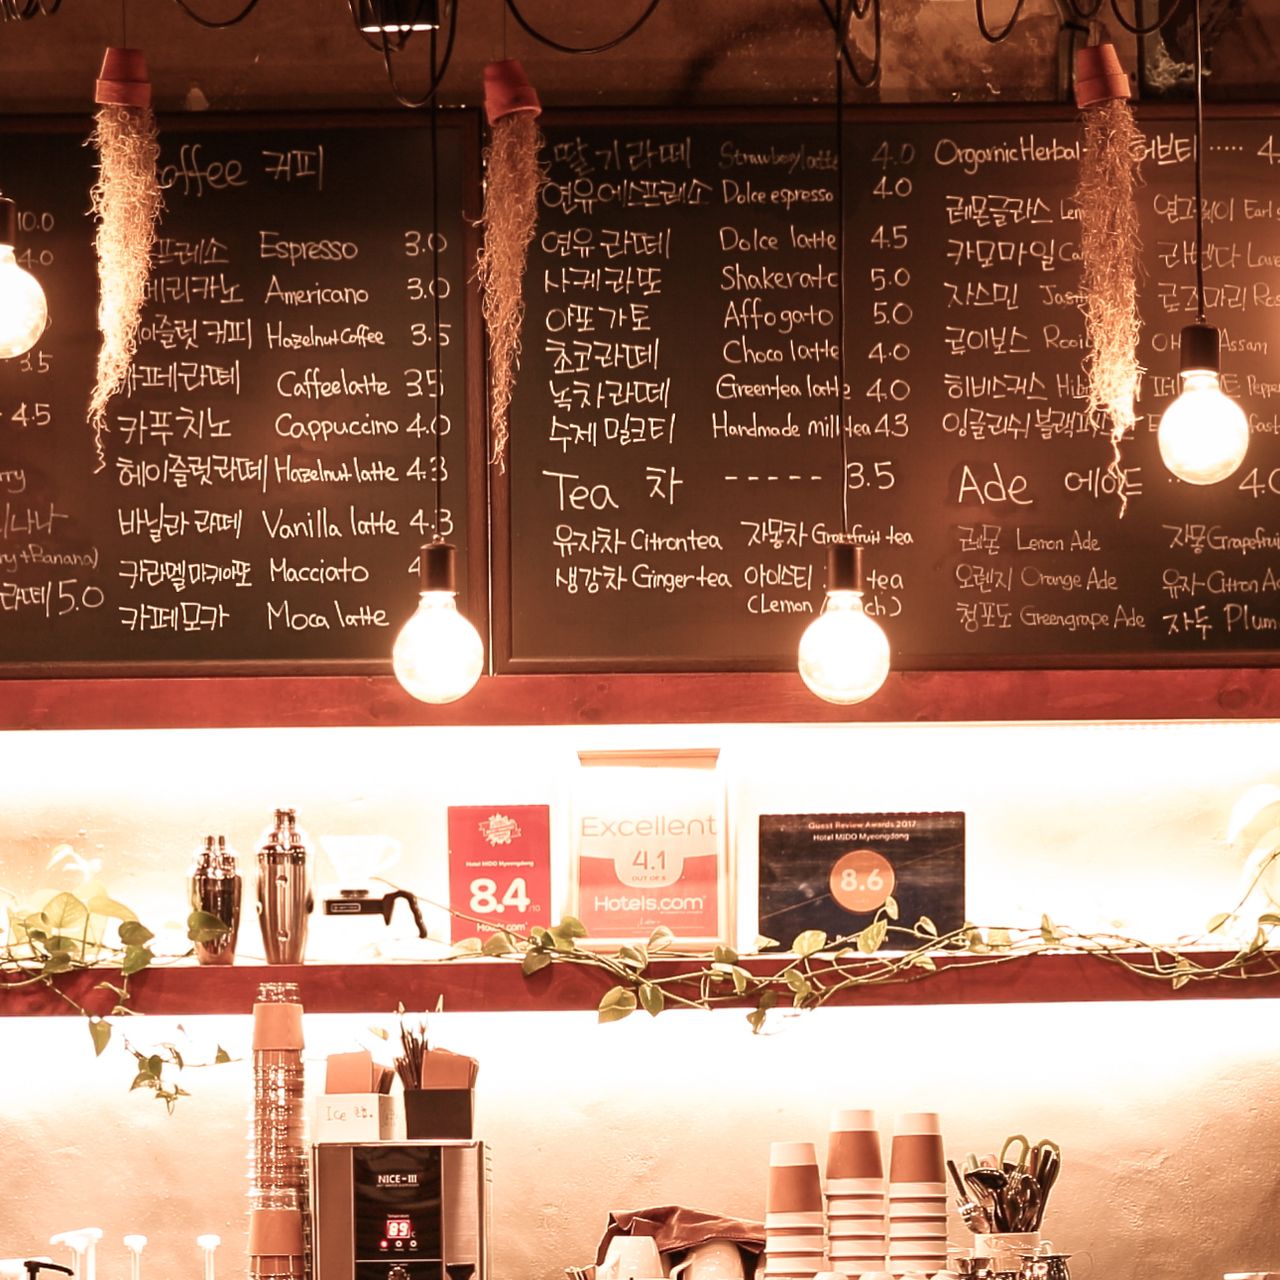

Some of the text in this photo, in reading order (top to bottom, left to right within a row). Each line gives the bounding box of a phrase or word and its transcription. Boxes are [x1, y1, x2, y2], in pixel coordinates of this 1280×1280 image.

[871, 140, 916, 170] 4.0
[1019, 133, 1080, 164] Herbal
[261, 144, 324, 192] 커피
[722, 178, 834, 211] Dolce espresso
[1243, 197, 1274, 220] Earl
[258, 230, 448, 267] Espresso 3.0
[719, 224, 908, 251] Dolce latte 4.5
[946, 239, 1055, 272] 카모마일
[264, 274, 451, 306] Americano 3.0
[870, 266, 911, 291] 5.0
[943, 281, 1020, 311] 자스민
[873, 301, 914, 325] 5.0
[202, 317, 453, 351] 커피 3.5
[722, 334, 911, 364] Choco latte 4.0
[944, 324, 1031, 355] 루이보스
[807, 374, 911, 402] latte 4.0
[942, 372, 1049, 401] 히비스커스
[11, 402, 52, 427] 4.5
[117, 407, 452, 446] 카푸치노 Cappuccino 4.0
[549, 414, 598, 454] 수제
[711, 410, 801, 438] Handmade
[405, 456, 449, 484] 4.3
[957, 461, 1034, 506] Ade
[541, 461, 895, 511] Tea 차 3.5
[261, 507, 344, 540] Vanilla
[349, 505, 400, 537] latte
[408, 508, 454, 537] 4.3
[740, 517, 914, 549] 자몽차 tea
[552, 524, 626, 559] 유자차
[957, 523, 1103, 556] 레몬 Lemon Ade
[1161, 523, 1207, 555] 자몽
[269, 556, 370, 585] Macciato
[555, 564, 629, 594] 생강차
[744, 563, 905, 591] 아이스티 tea
[954, 562, 1119, 595] 오렌지 Orange Ade
[1161, 567, 1206, 599] 유자
[1206, 570, 1259, 594] Citron
[58, 579, 105, 616] 5.0
[266, 600, 330, 632] Moca
[333, 600, 391, 631] latte
[954, 601, 1012, 634] 청포도
[1111, 603, 1146, 629] Ade
[1162, 605, 1212, 641] 자두
[1222, 603, 1278, 633] Plum
[581, 815, 718, 843] Excellent
[808, 820, 917, 830] Guest Review Awards 2017
[812, 832, 910, 842] Hotel MIDO Myeongdong
[632, 850, 666, 871] 4.1
[469, 877, 531, 913] 8.4
[840, 869, 885, 892] 8.6
[593, 895, 704, 913] Hotels.com
[388, 1221, 410, 1237] 89
